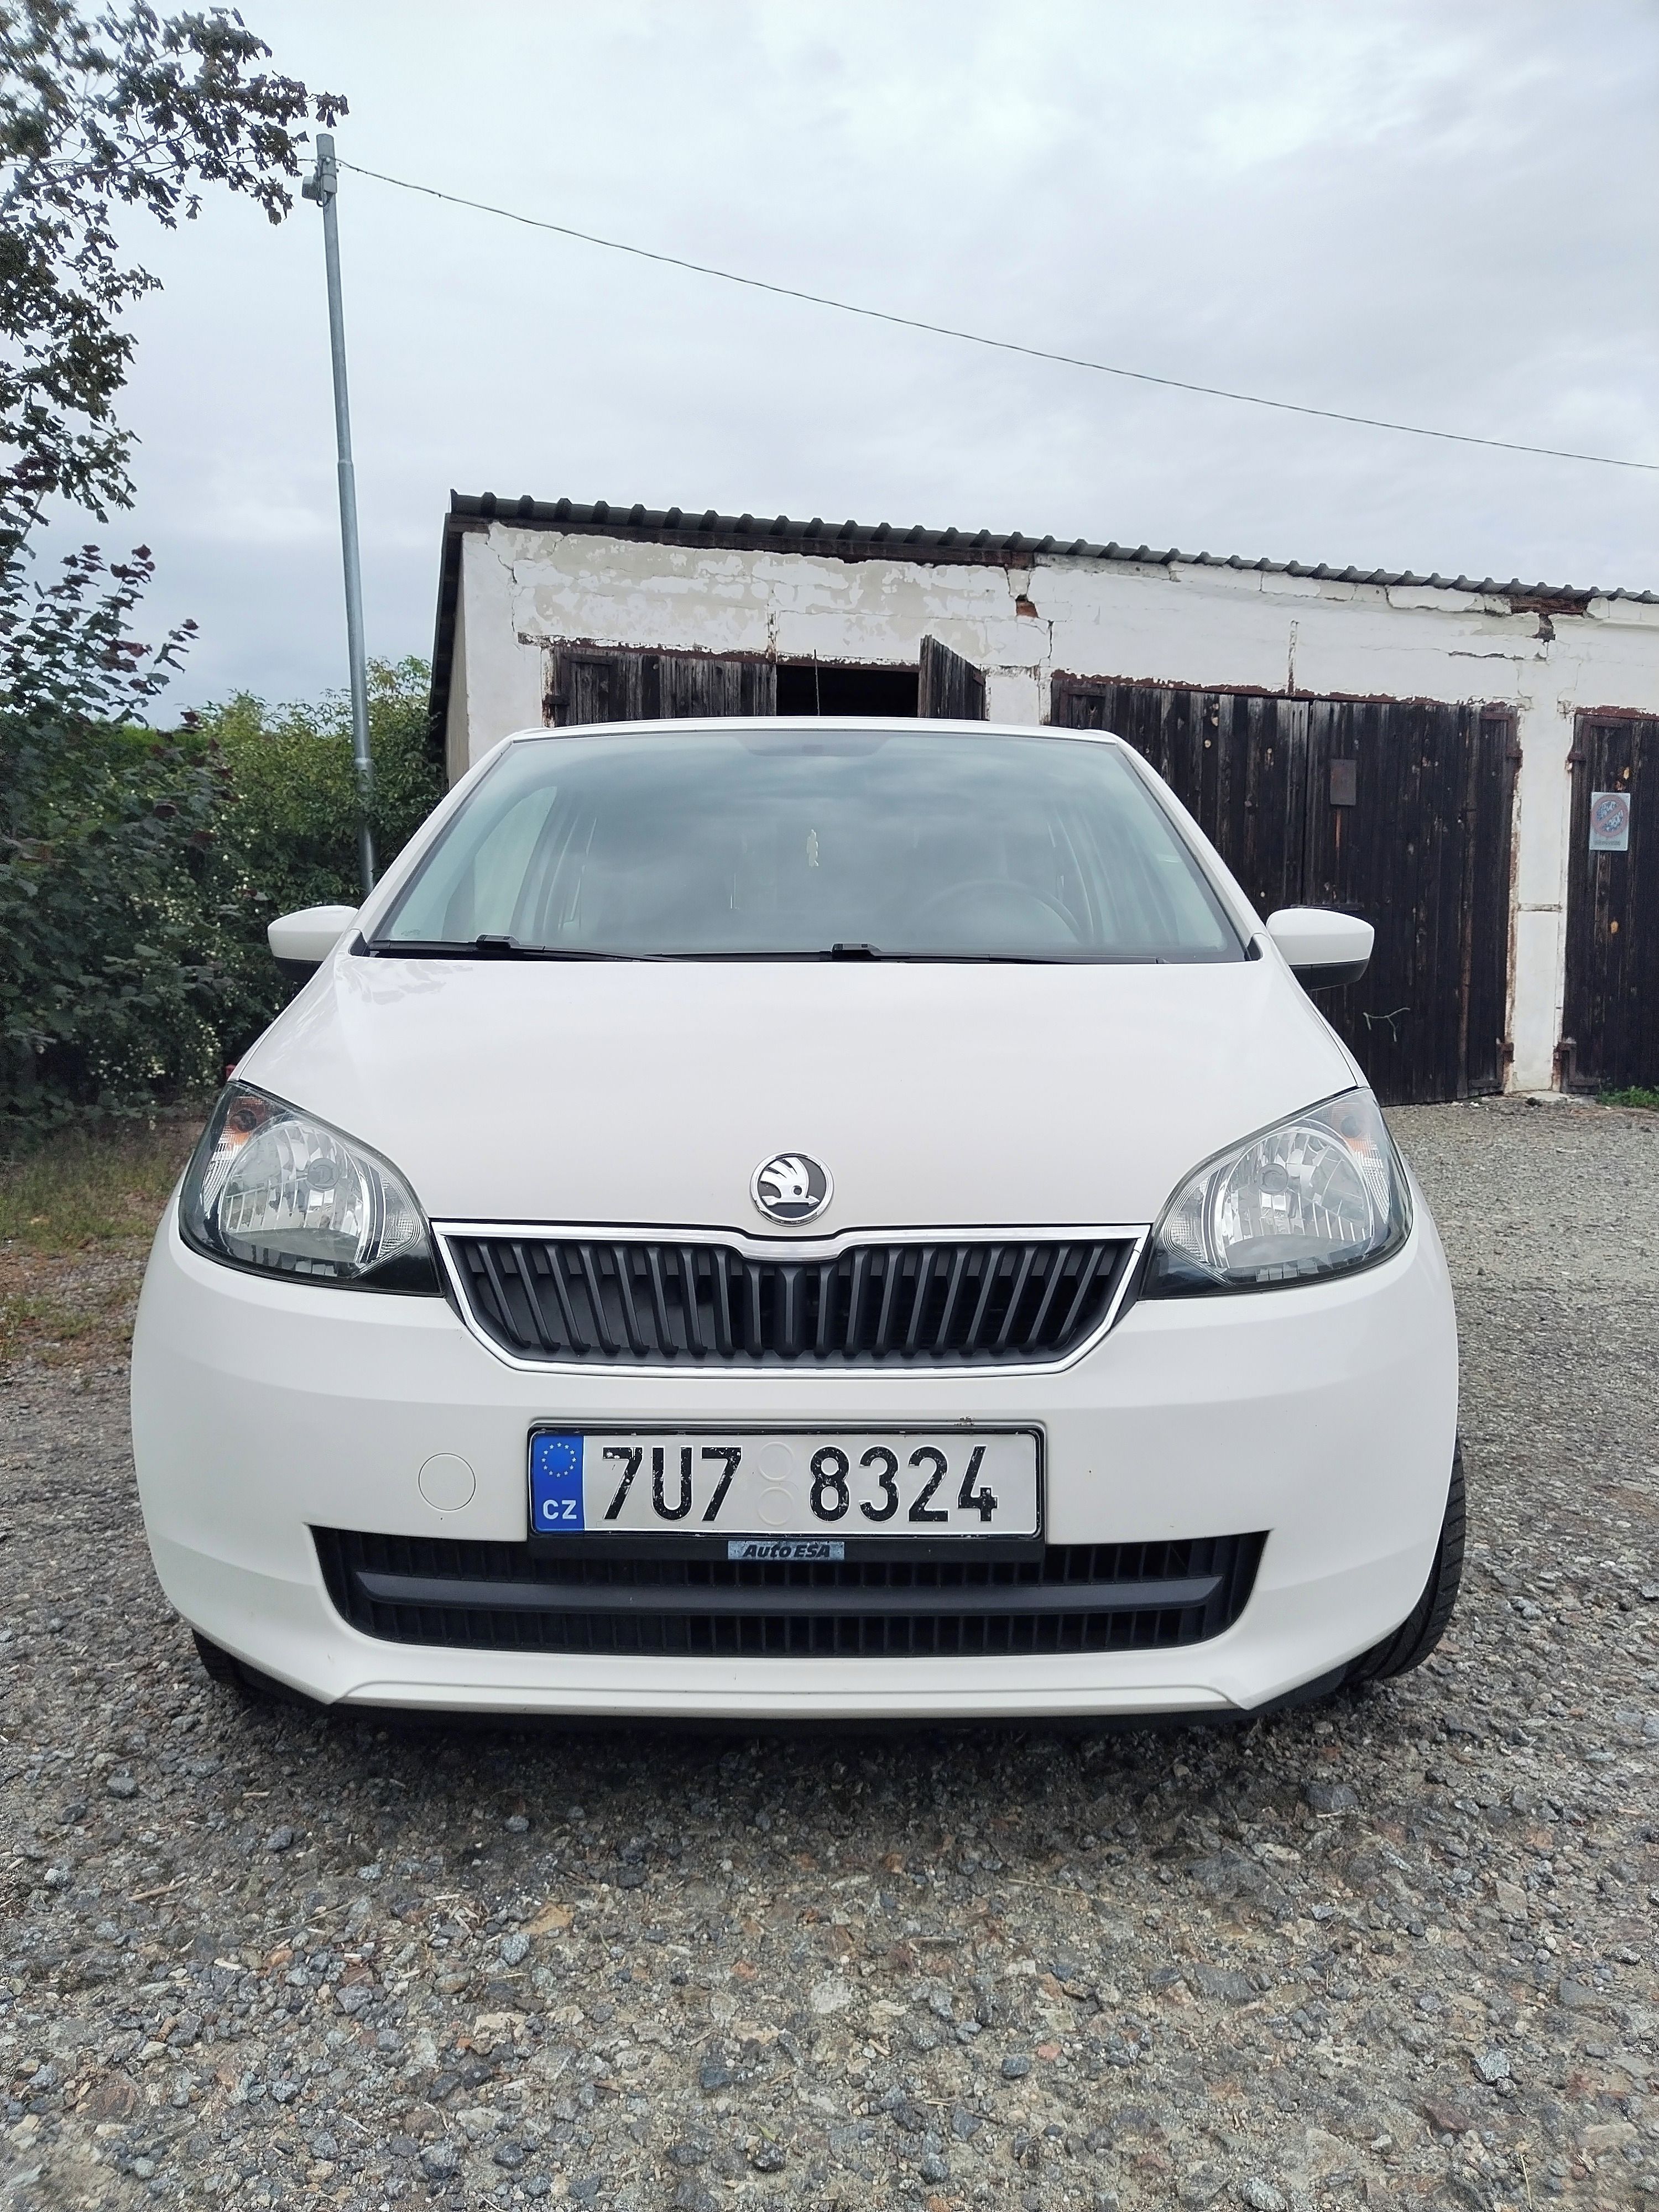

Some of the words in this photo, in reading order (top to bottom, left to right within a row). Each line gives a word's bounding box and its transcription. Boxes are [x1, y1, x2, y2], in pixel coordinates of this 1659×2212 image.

[602, 1447, 742, 1521] 7U7
[810, 1445, 998, 1522] 8324
[543, 1500, 577, 1519] CZ
[743, 1543, 792, 1558] Auto
[794, 1545, 830, 1558] ESA
